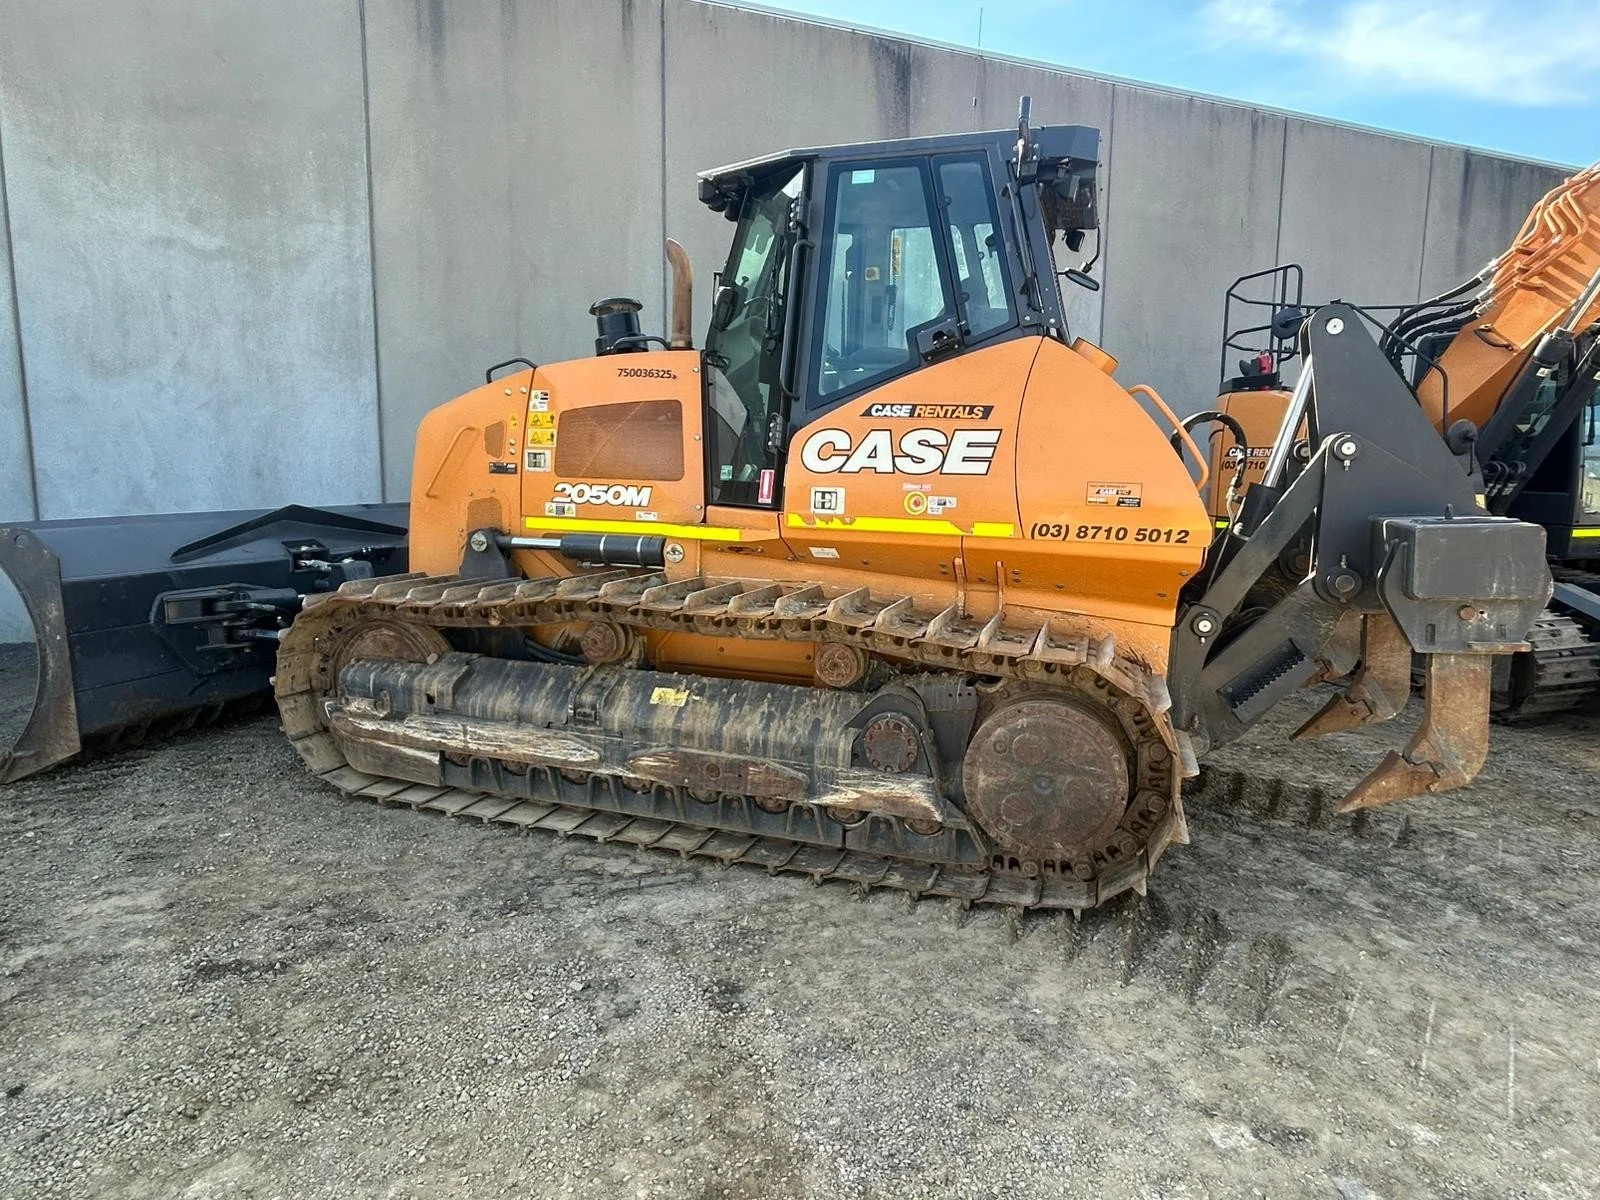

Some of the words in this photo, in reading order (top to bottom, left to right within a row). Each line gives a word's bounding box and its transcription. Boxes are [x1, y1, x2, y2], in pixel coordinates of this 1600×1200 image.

[617, 368, 672, 379] 750036325
[871, 404, 912, 417] CASE
[914, 405, 984, 419] RENTALS
[801, 428, 1002, 475] CASE
[1246, 461, 1266, 470] 710
[552, 482, 653, 507] 2050M
[1031, 523, 1070, 541] (03)
[1076, 525, 1128, 541] 8710
[1134, 528, 1190, 544] 5012
